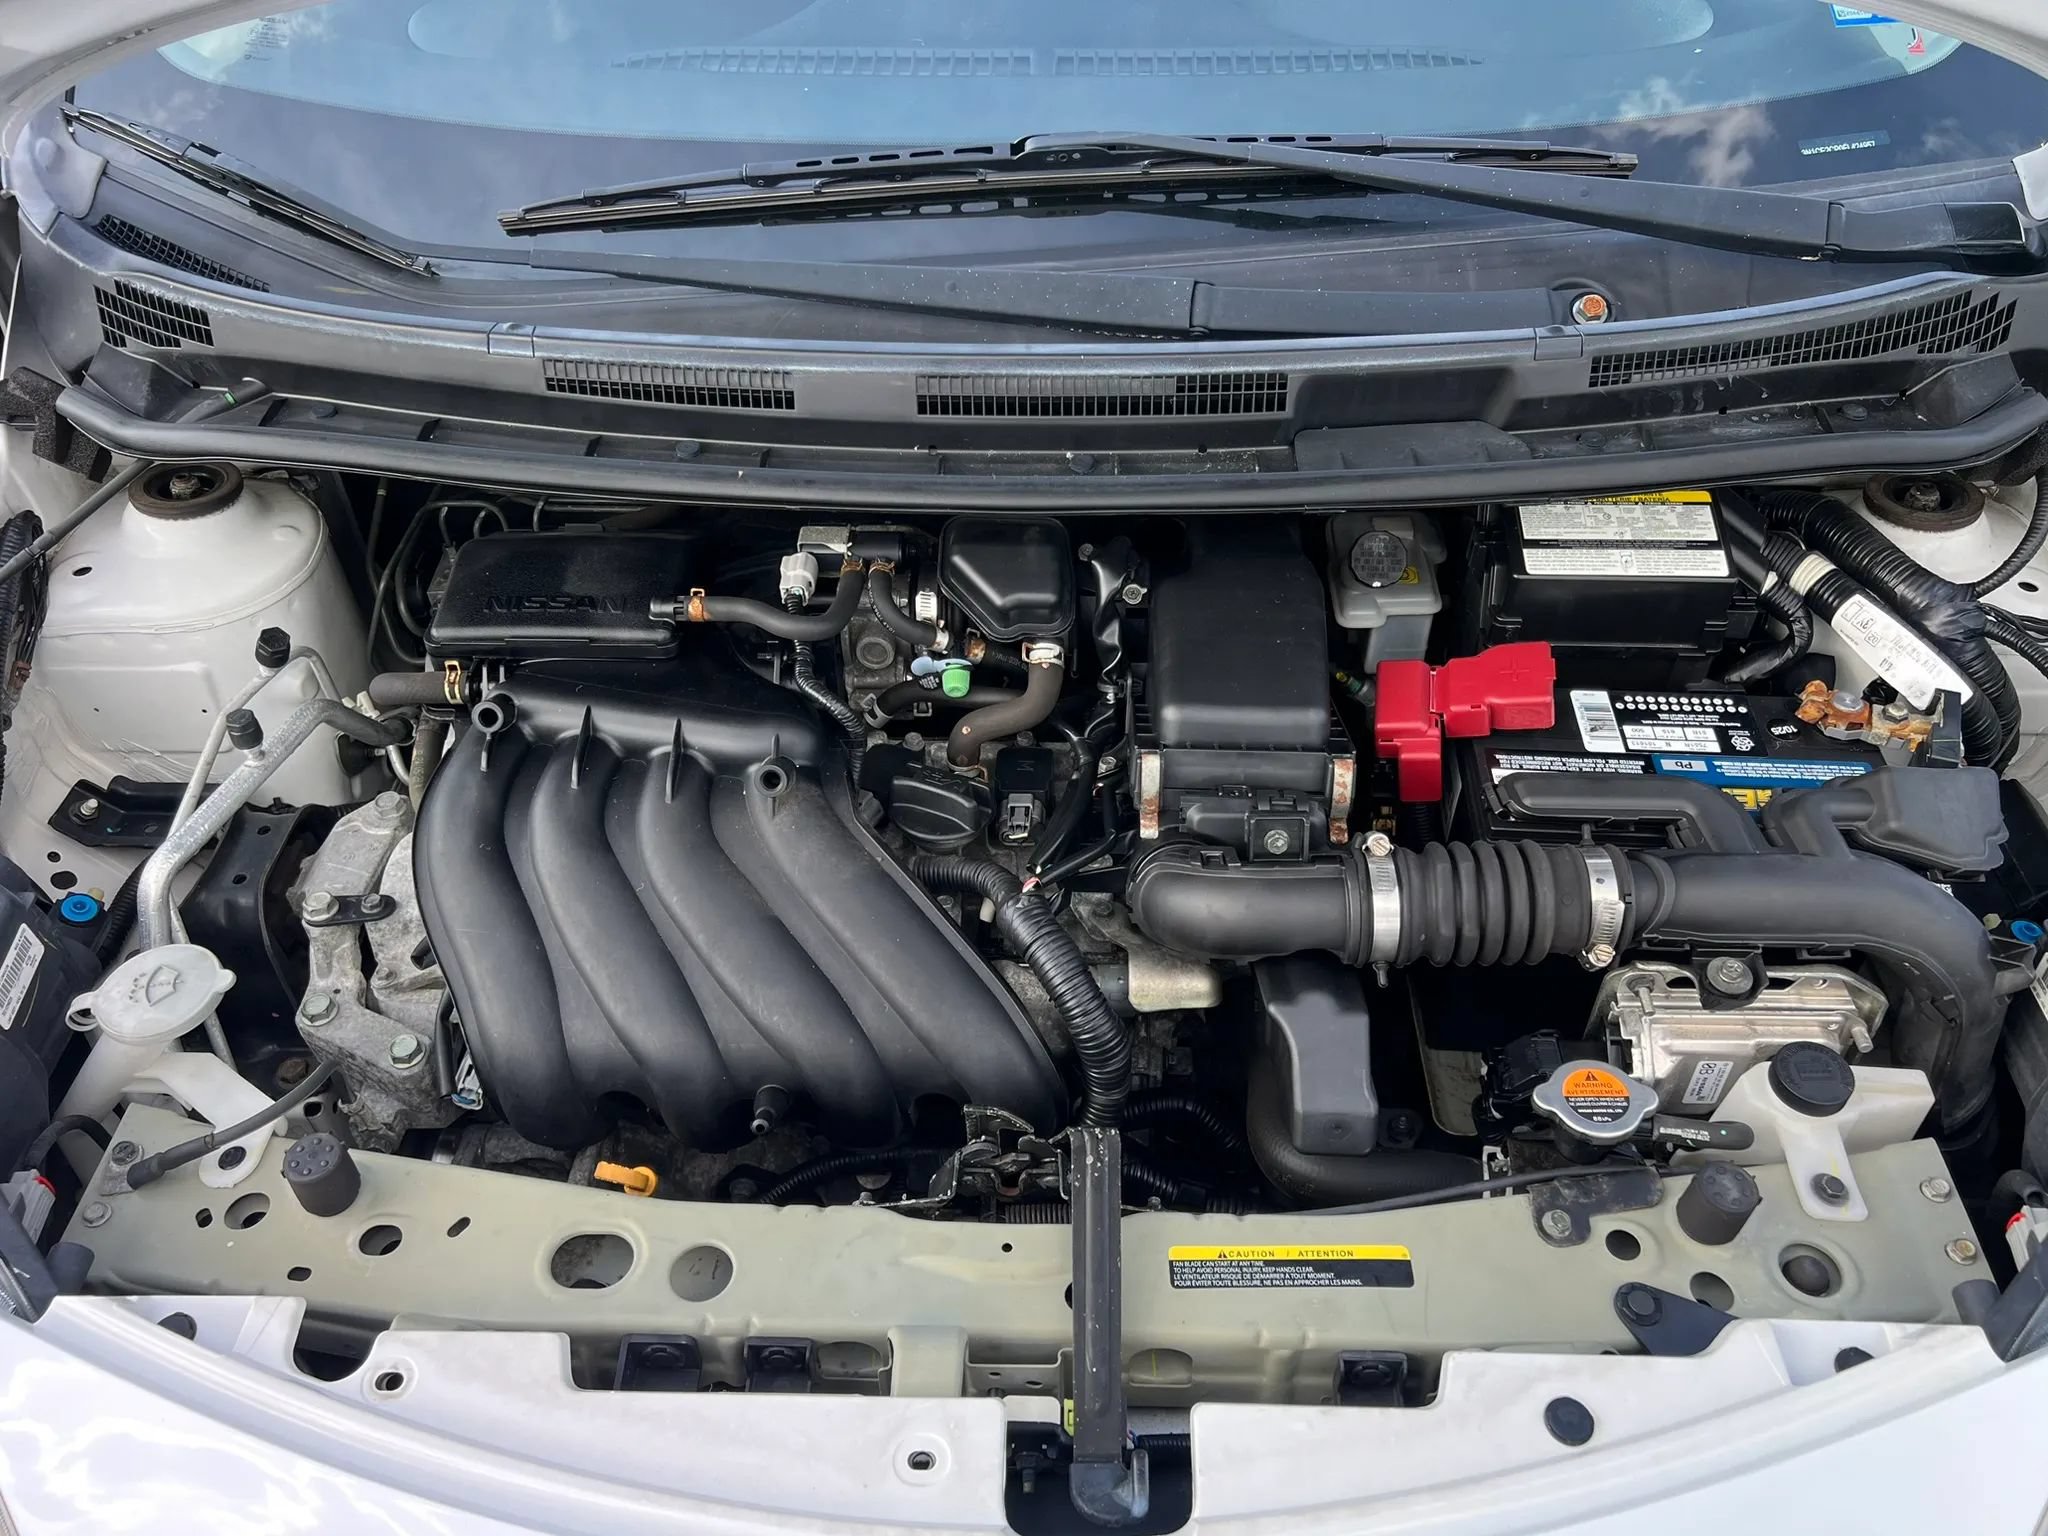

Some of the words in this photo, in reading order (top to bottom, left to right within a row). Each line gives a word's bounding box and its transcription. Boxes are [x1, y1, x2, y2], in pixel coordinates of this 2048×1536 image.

[483, 597, 624, 613] NISSAN
[1770, 725, 1798, 735] 10/25
[1675, 761, 1693, 770] Pb
[1228, 1250, 1275, 1258] CAUTION
[1298, 1250, 1354, 1258] ATTENTION
